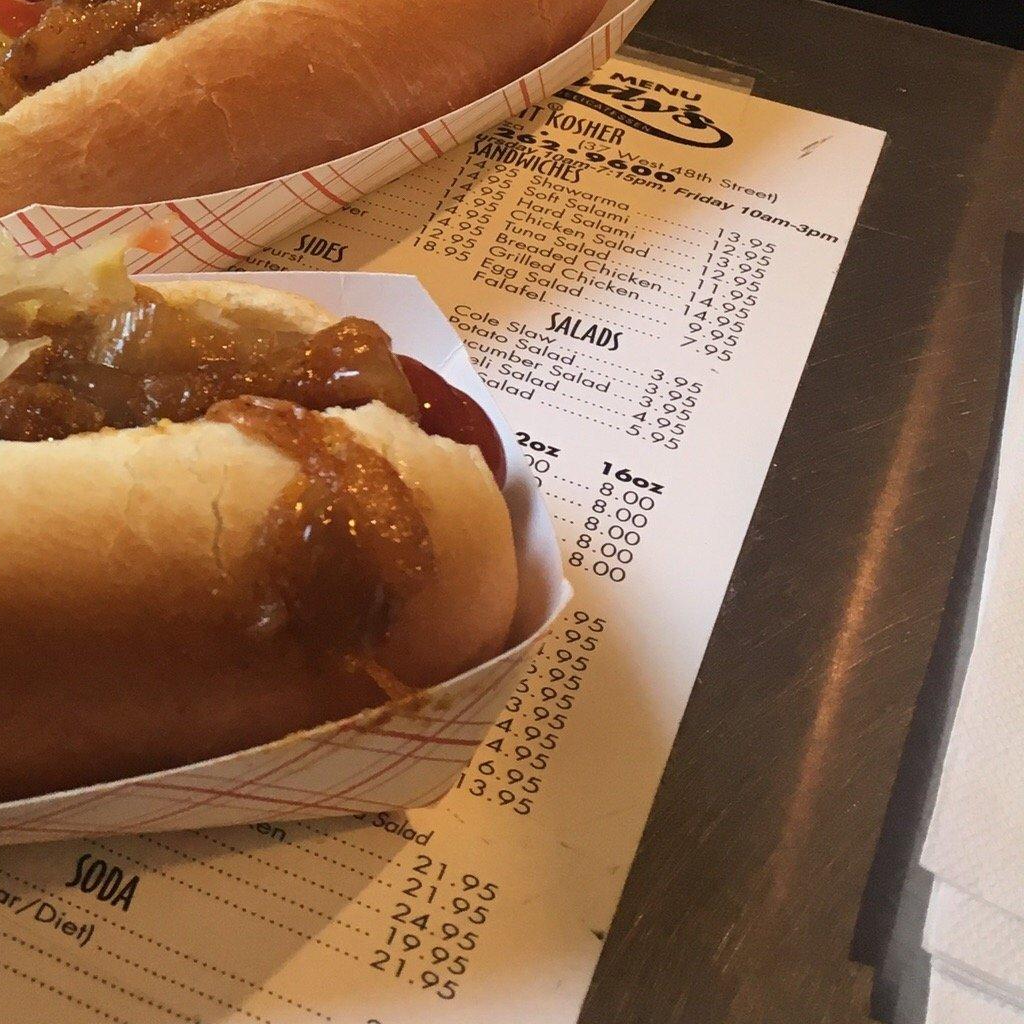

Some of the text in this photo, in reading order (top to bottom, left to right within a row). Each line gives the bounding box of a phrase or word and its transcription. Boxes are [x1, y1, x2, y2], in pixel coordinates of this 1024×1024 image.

[610, 72, 702, 101] MENU
[545, 110, 626, 145] KOSHER
[458, 167, 513, 189] 14.95
[465, 156, 520, 178] 14.95
[469, 140, 586, 183] SANDWICHES
[577, 139, 611, 153] (37
[618, 150, 664, 169] West
[671, 166, 712, 184] 48th
[719, 178, 778, 204] Street)
[443, 189, 499, 212] 14.95
[450, 178, 506, 201] 14.95
[427, 212, 485, 236] 14.95
[435, 201, 492, 224] 14.95
[524, 186, 771, 267] Soft Salami 12.95
[530, 175, 776, 254] Shawarma 13.95
[673, 186, 734, 211] Friday
[741, 206, 839, 243] 10am-3pm
[293, 234, 349, 263] SIDES
[413, 237, 471, 261] 18.95
[420, 224, 477, 248] 12.95
[510, 209, 761, 293] Chicken Salad 12.95
[517, 197, 766, 280] Hard Salami 13.95
[496, 232, 749, 319] Breaded Chicken 14.95
[504, 220, 758, 306] Tuna Salad 11.95
[480, 257, 739, 347] Egg Salad 9.95
[489, 245, 744, 333] Grilled Chicken 14.95
[473, 270, 733, 362] Falafel 7.95
[545, 312, 623, 351] SALADS
[449, 315, 698, 408] Potato Salad 3.95
[454, 305, 703, 394] Cole Slaw 3.95
[498, 363, 560, 391] Salad
[632, 412, 686, 435] 4.95
[549, 365, 611, 393] Salad
[638, 396, 692, 420] 3.95
[626, 424, 680, 450] 5.95
[599, 482, 655, 511] 8.00
[601, 461, 666, 495] 16oz
[584, 516, 641, 546] 8.00
[592, 499, 648, 528] 8.00
[568, 551, 626, 582] 8.00
[576, 534, 633, 564] 8.00
[516, 679, 575, 710] 5.95
[506, 696, 568, 731] 3.95
[496, 718, 559, 751] 4.95
[486, 738, 550, 770] 4.95
[456, 773, 534, 816] 13.95
[478, 759, 542, 794] 6.95
[372, 811, 434, 846] Salad
[65, 853, 141, 912] SODA
[413, 854, 499, 902] 21.95
[402, 877, 489, 925] 21.95
[391, 902, 479, 951] 24.95
[386, 926, 469, 976] 19.95
[370, 949, 459, 1001] 21.95
